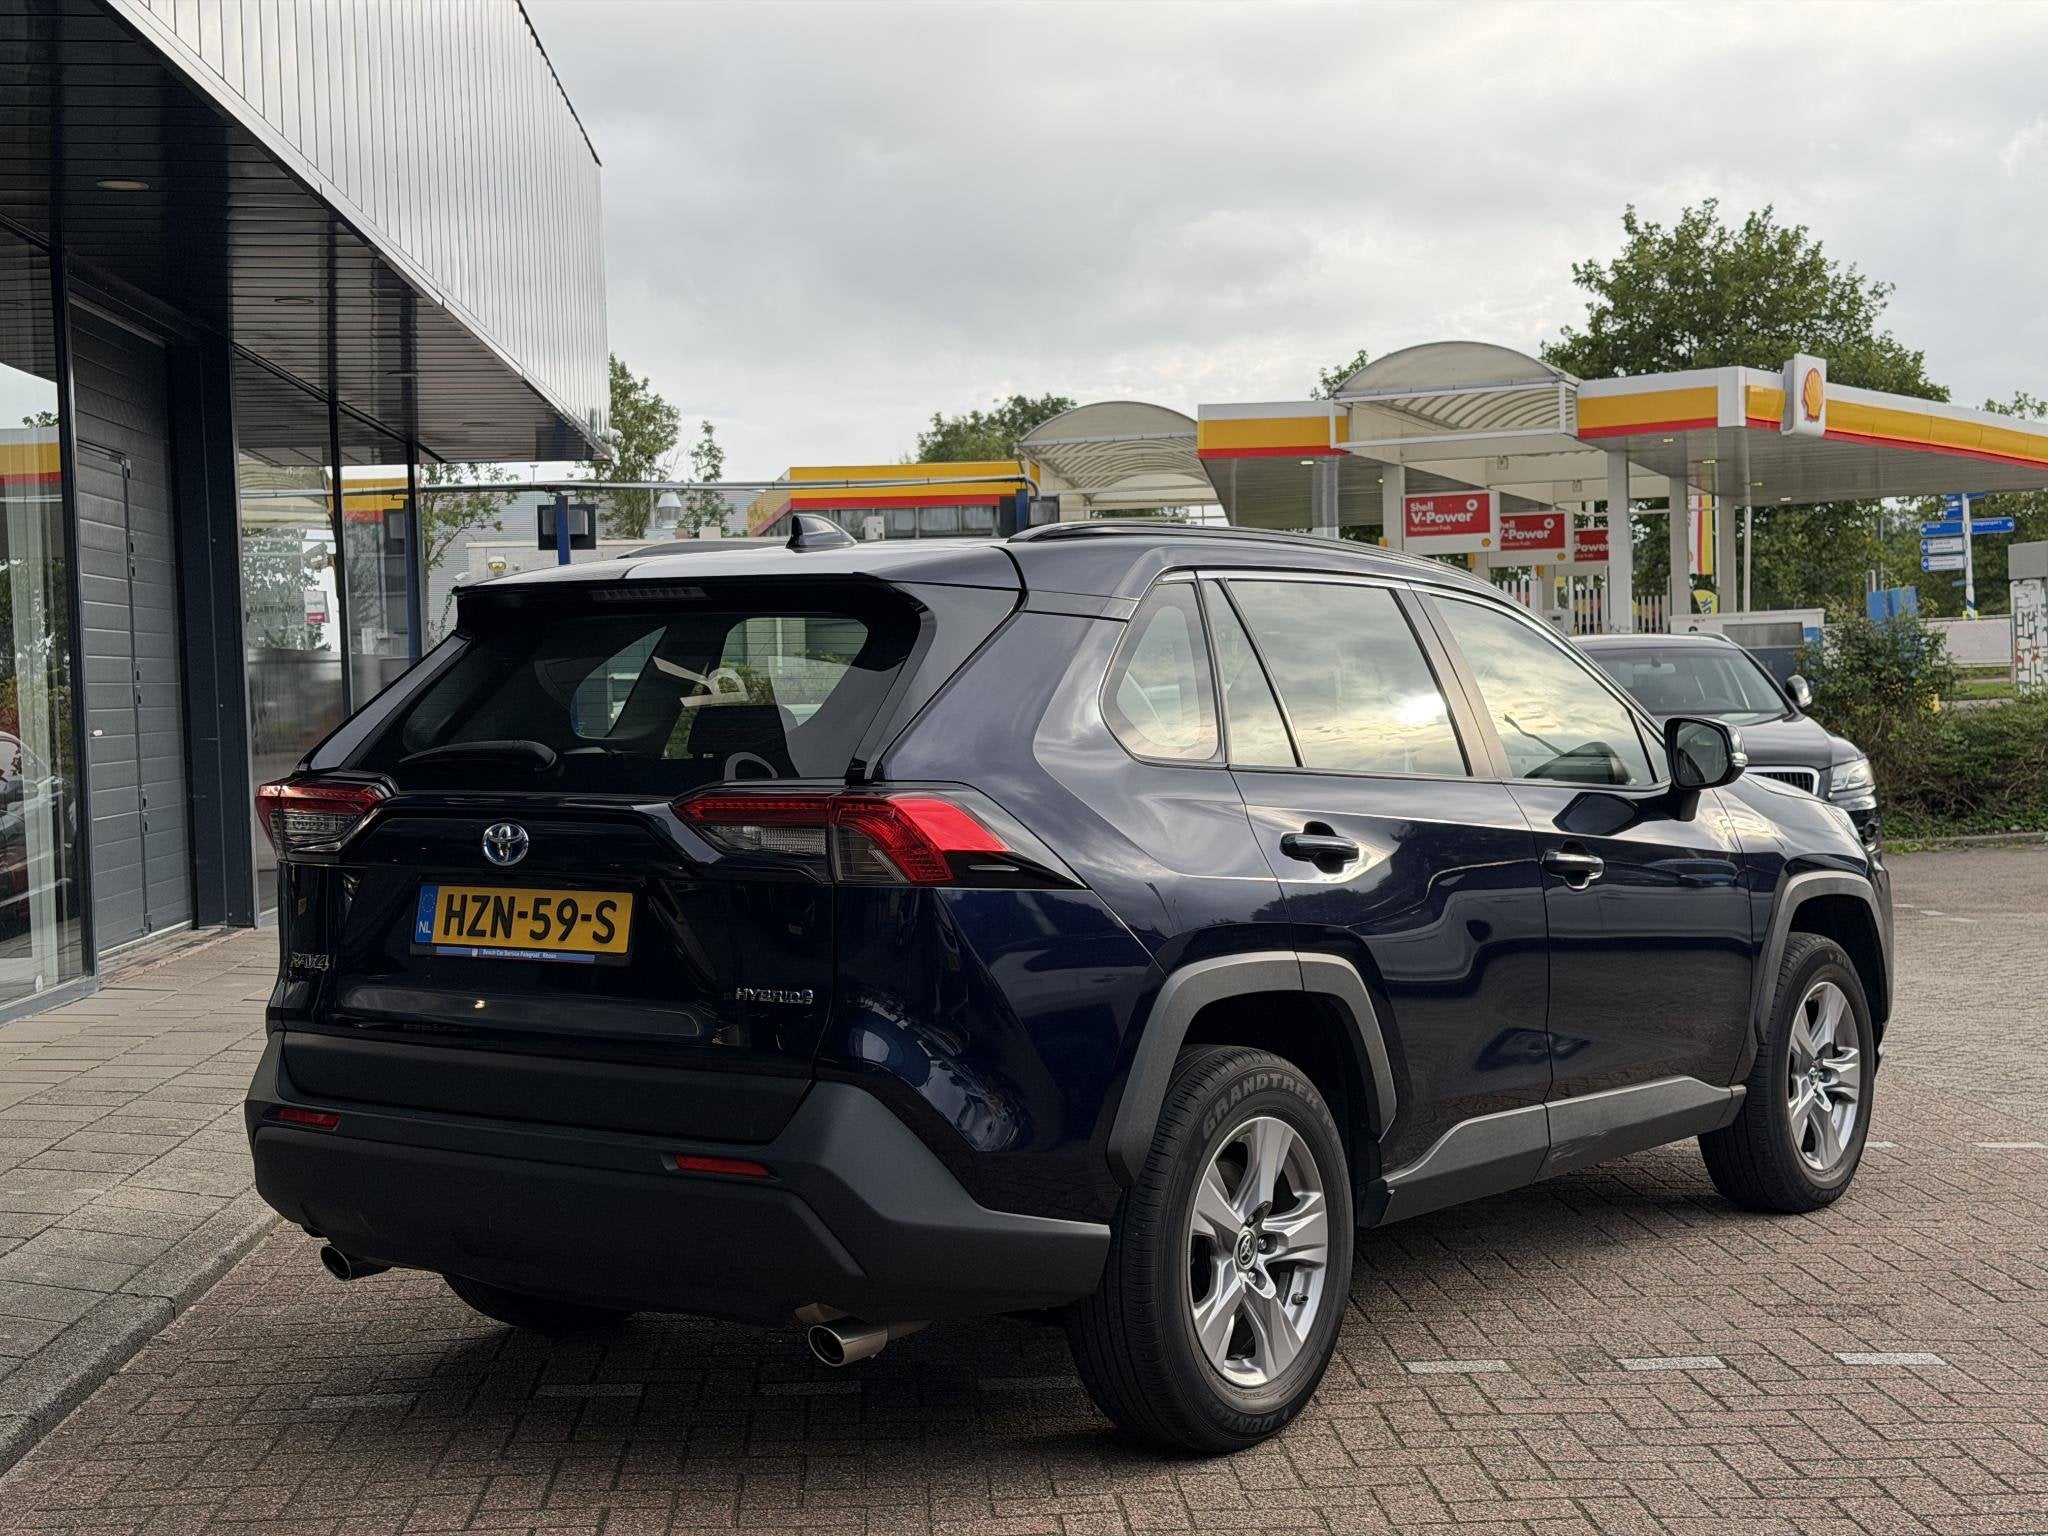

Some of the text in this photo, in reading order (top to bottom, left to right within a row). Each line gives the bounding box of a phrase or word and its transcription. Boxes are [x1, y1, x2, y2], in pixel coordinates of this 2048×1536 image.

[1410, 501, 1434, 512] Shell
[1410, 512, 1474, 524] V-Power
[1501, 519, 1516, 529] hell
[443, 894, 618, 944] HZN-59-S
[418, 921, 431, 934] NL
